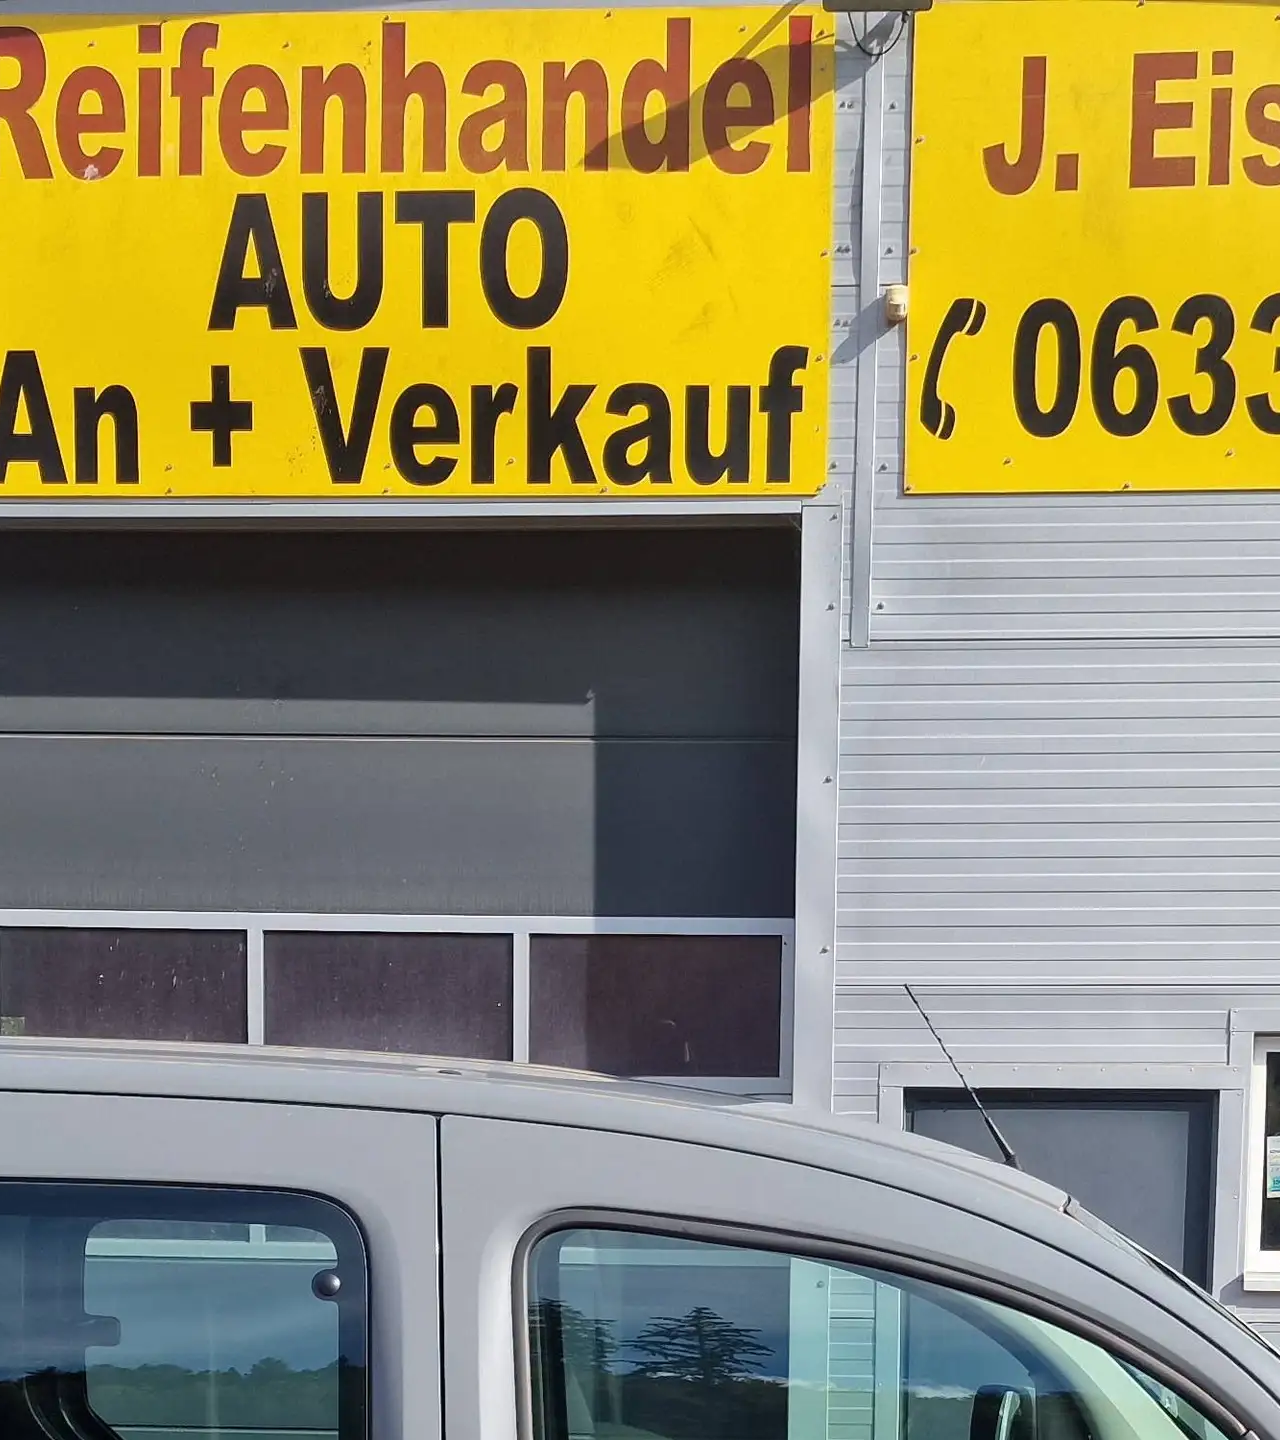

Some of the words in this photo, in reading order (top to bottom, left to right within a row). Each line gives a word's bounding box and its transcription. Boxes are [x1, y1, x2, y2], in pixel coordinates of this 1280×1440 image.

[982, 55, 1081, 196] J.
[207, 186, 570, 332] AUTO
[189, 364, 253, 468] +
[298, 344, 810, 487] Verkauf
